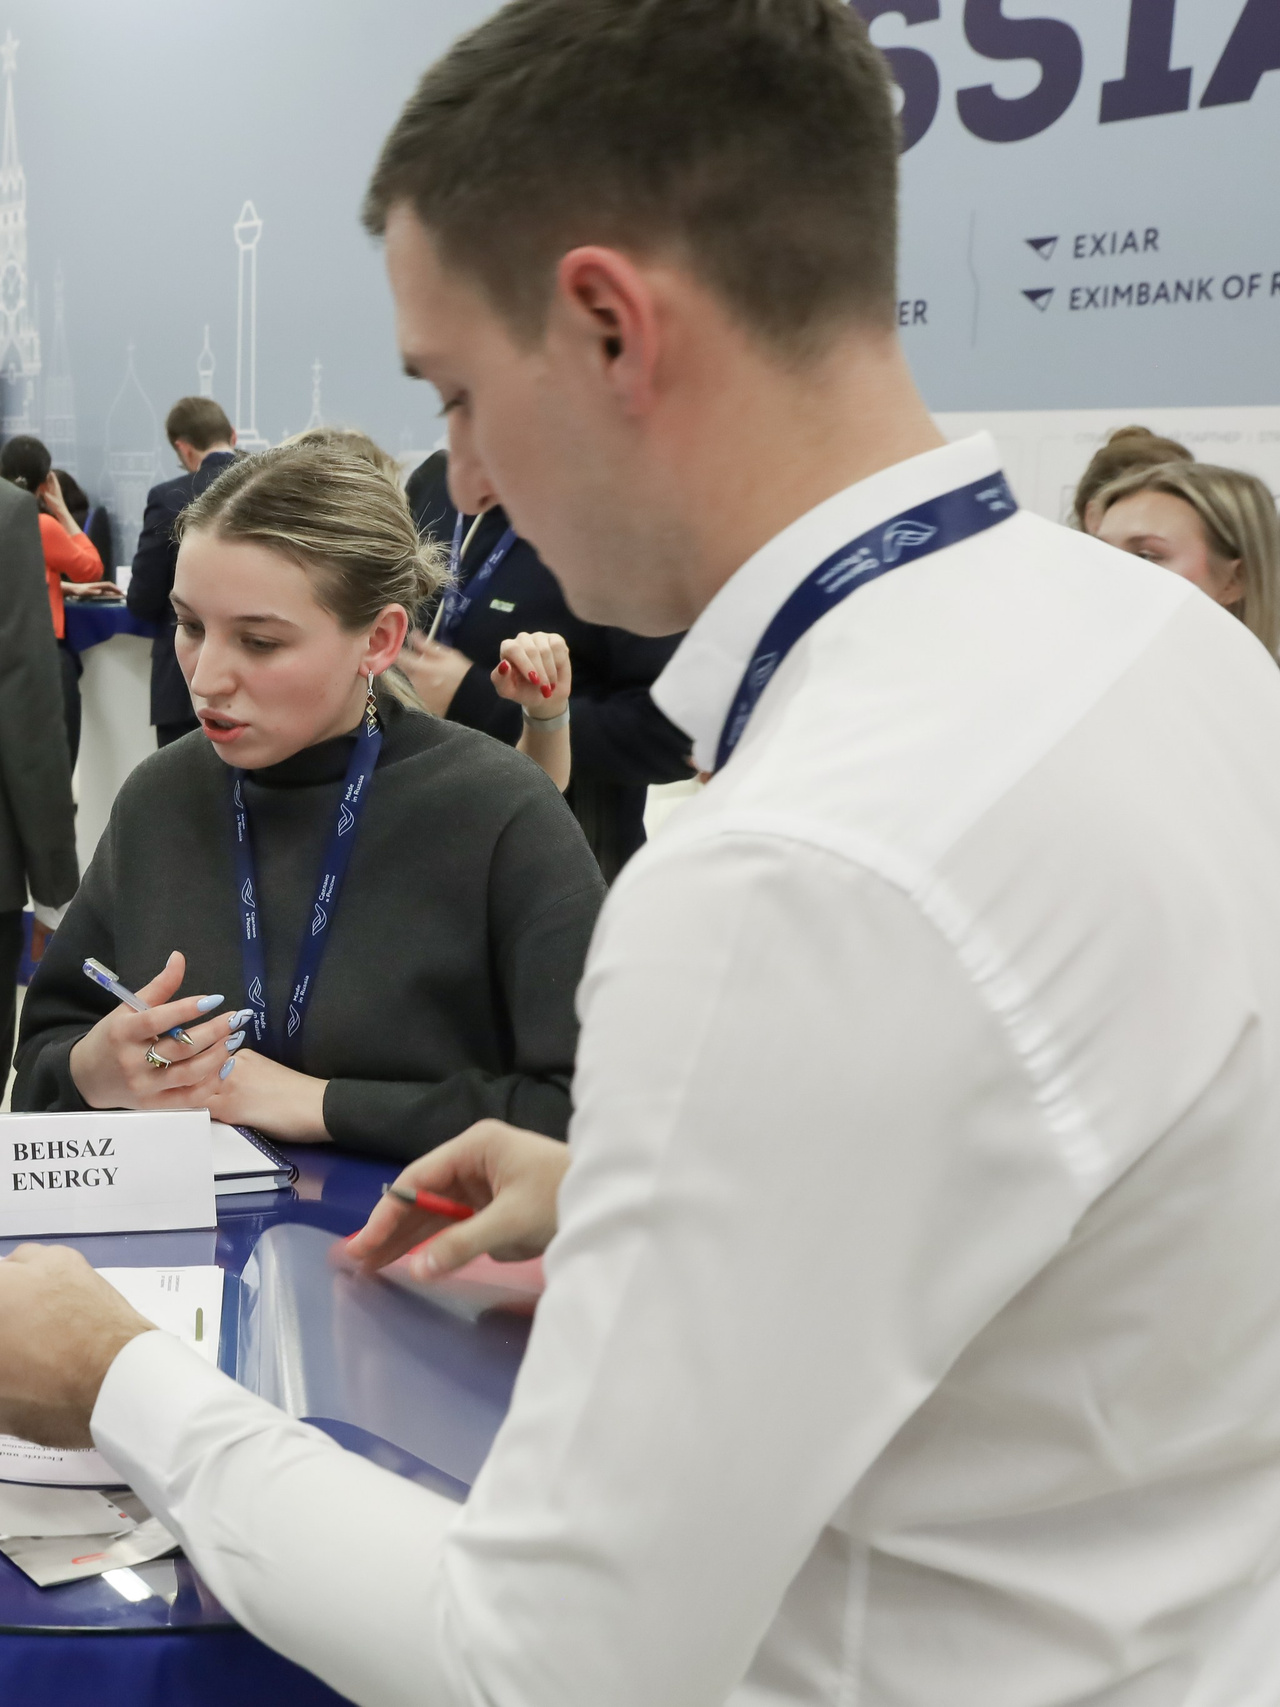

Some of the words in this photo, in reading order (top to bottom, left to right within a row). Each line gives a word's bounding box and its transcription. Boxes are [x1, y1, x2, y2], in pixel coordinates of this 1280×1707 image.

[1073, 228, 1160, 259] EXIAR
[1068, 276, 1215, 311] EXIMBANK
[1221, 273, 1262, 300] OF
[344, 783, 355, 801] Made
[353, 774, 365, 796] Russia
[292, 984, 301, 1002] Made
[299, 975, 310, 996] Russia
[254, 1019, 262, 1041] Russia
[12, 1137, 116, 1162] BEHSAZ
[11, 1166, 120, 1191] ENERGY
